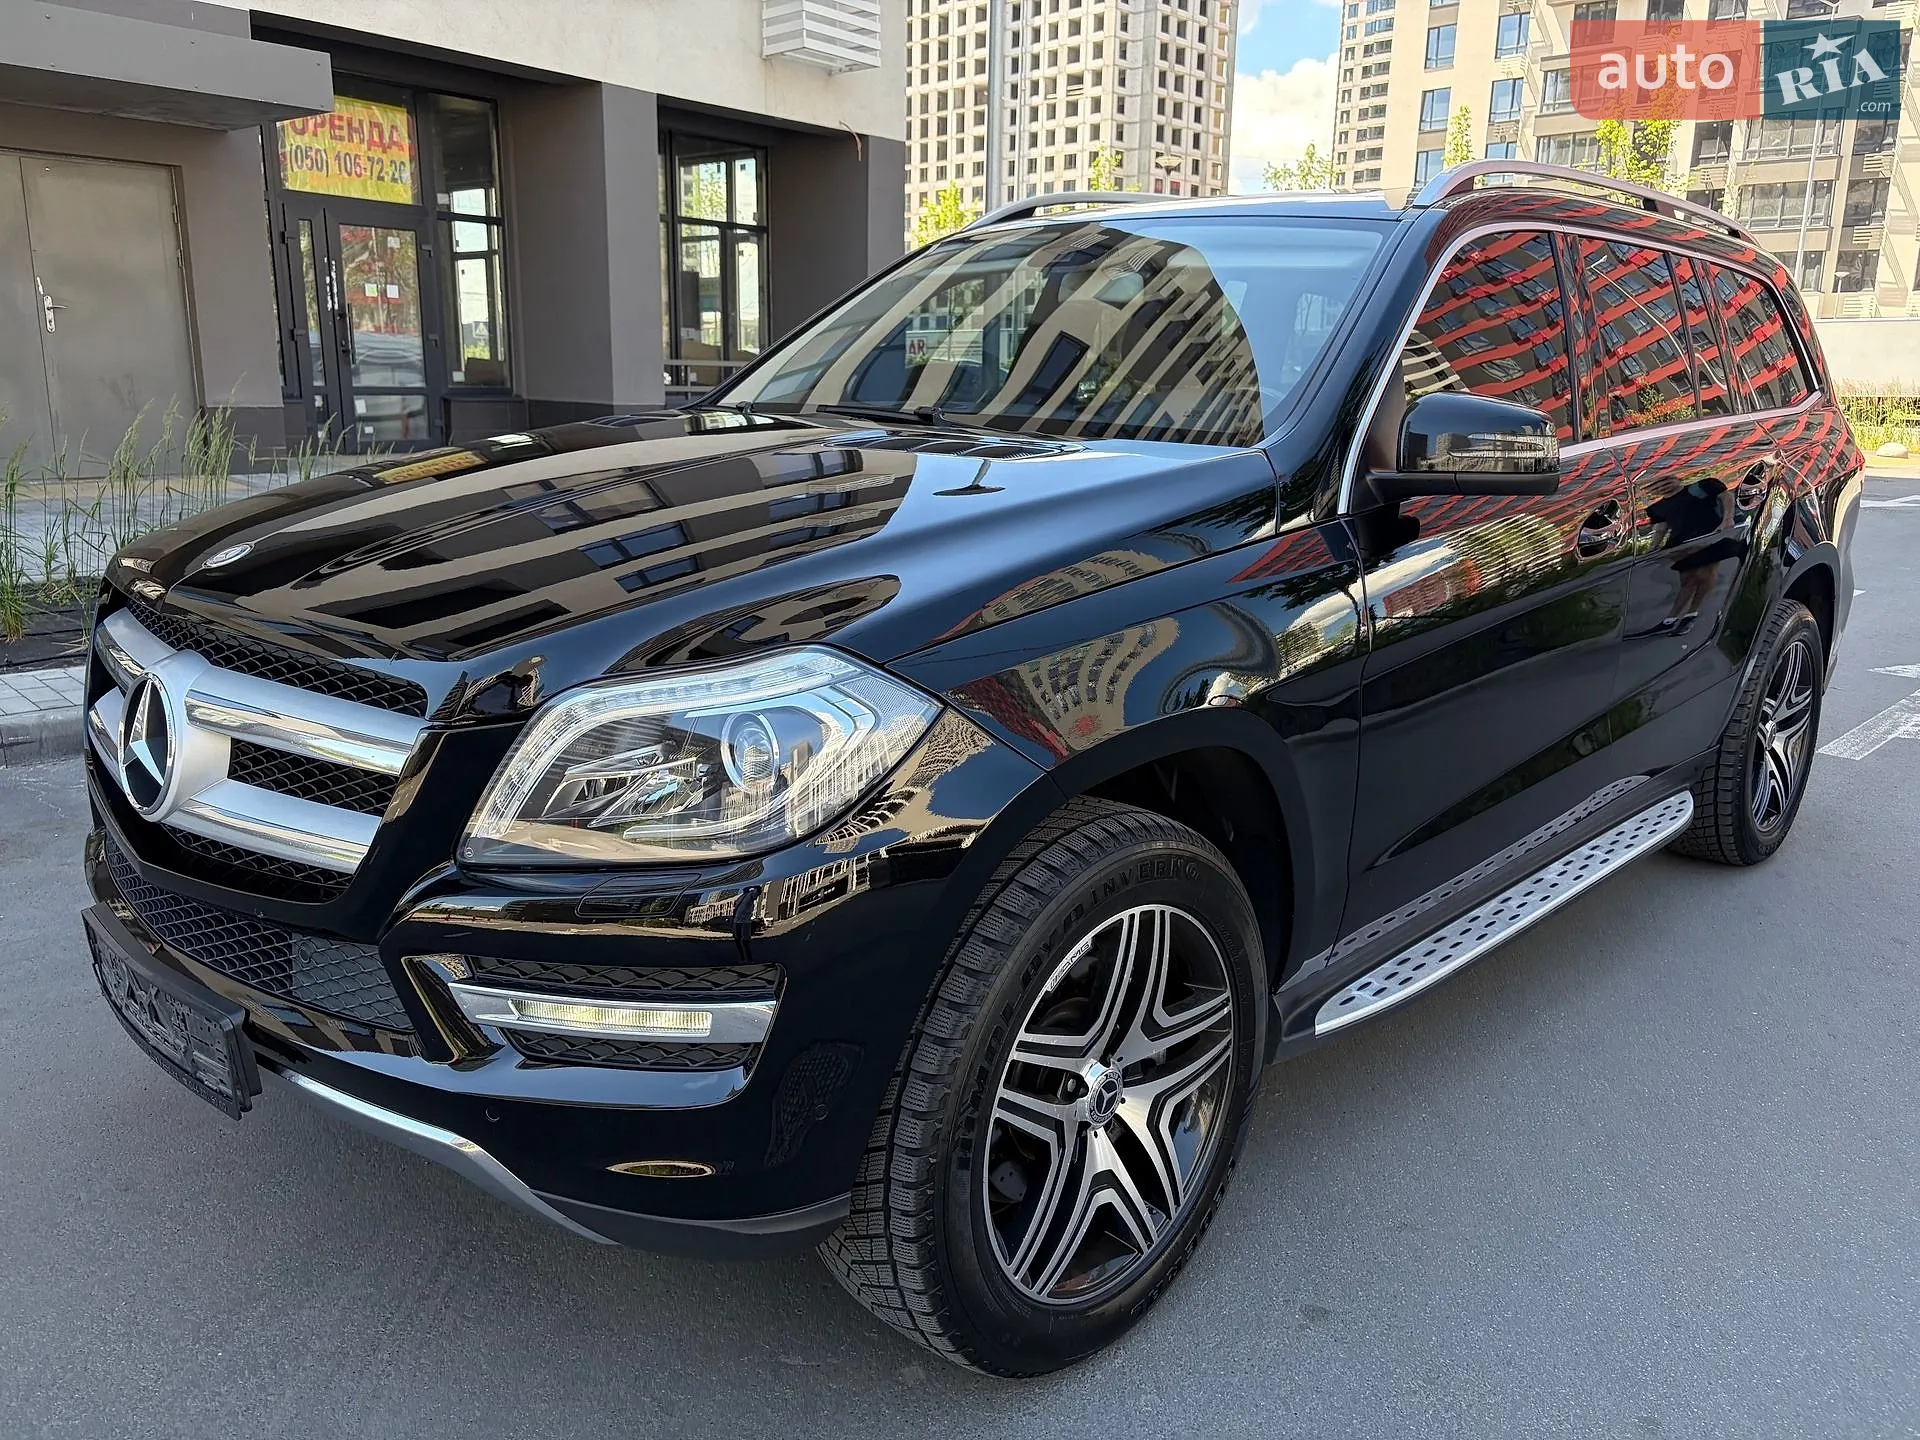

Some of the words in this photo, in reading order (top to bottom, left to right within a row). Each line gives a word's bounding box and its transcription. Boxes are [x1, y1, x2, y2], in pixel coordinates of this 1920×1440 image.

[290, 114, 405, 153] ОРЕНДА
[290, 143, 329, 178] (050)
[1090, 857, 1203, 904] INVERNO
